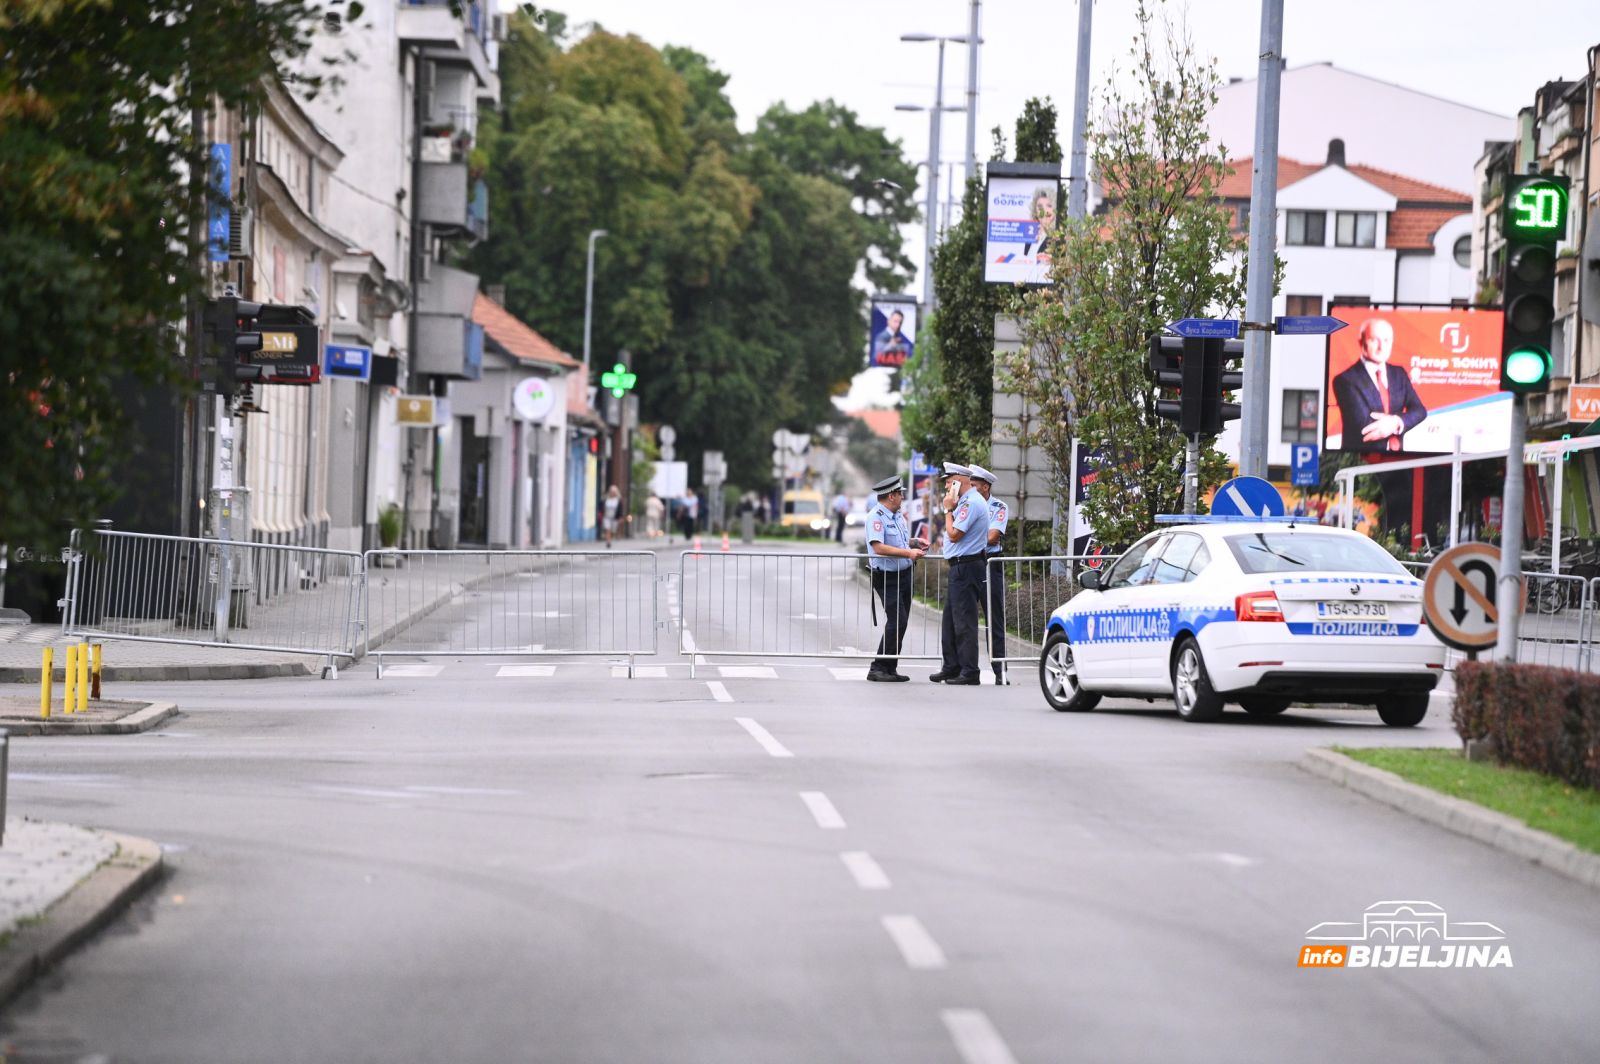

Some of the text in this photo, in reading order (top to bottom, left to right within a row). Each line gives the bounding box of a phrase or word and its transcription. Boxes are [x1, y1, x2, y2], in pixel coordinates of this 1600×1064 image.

[1516, 189, 1560, 228] 50
[1028, 225, 1034, 235] 2
[263, 335, 294, 350] -Mi
[1297, 446, 1312, 468] P
[1326, 604, 1386, 615] T54-J-730
[1099, 614, 1158, 640] ПОЛИЦИЈА
[1312, 622, 1399, 636] ПОЛИЦИЈА
